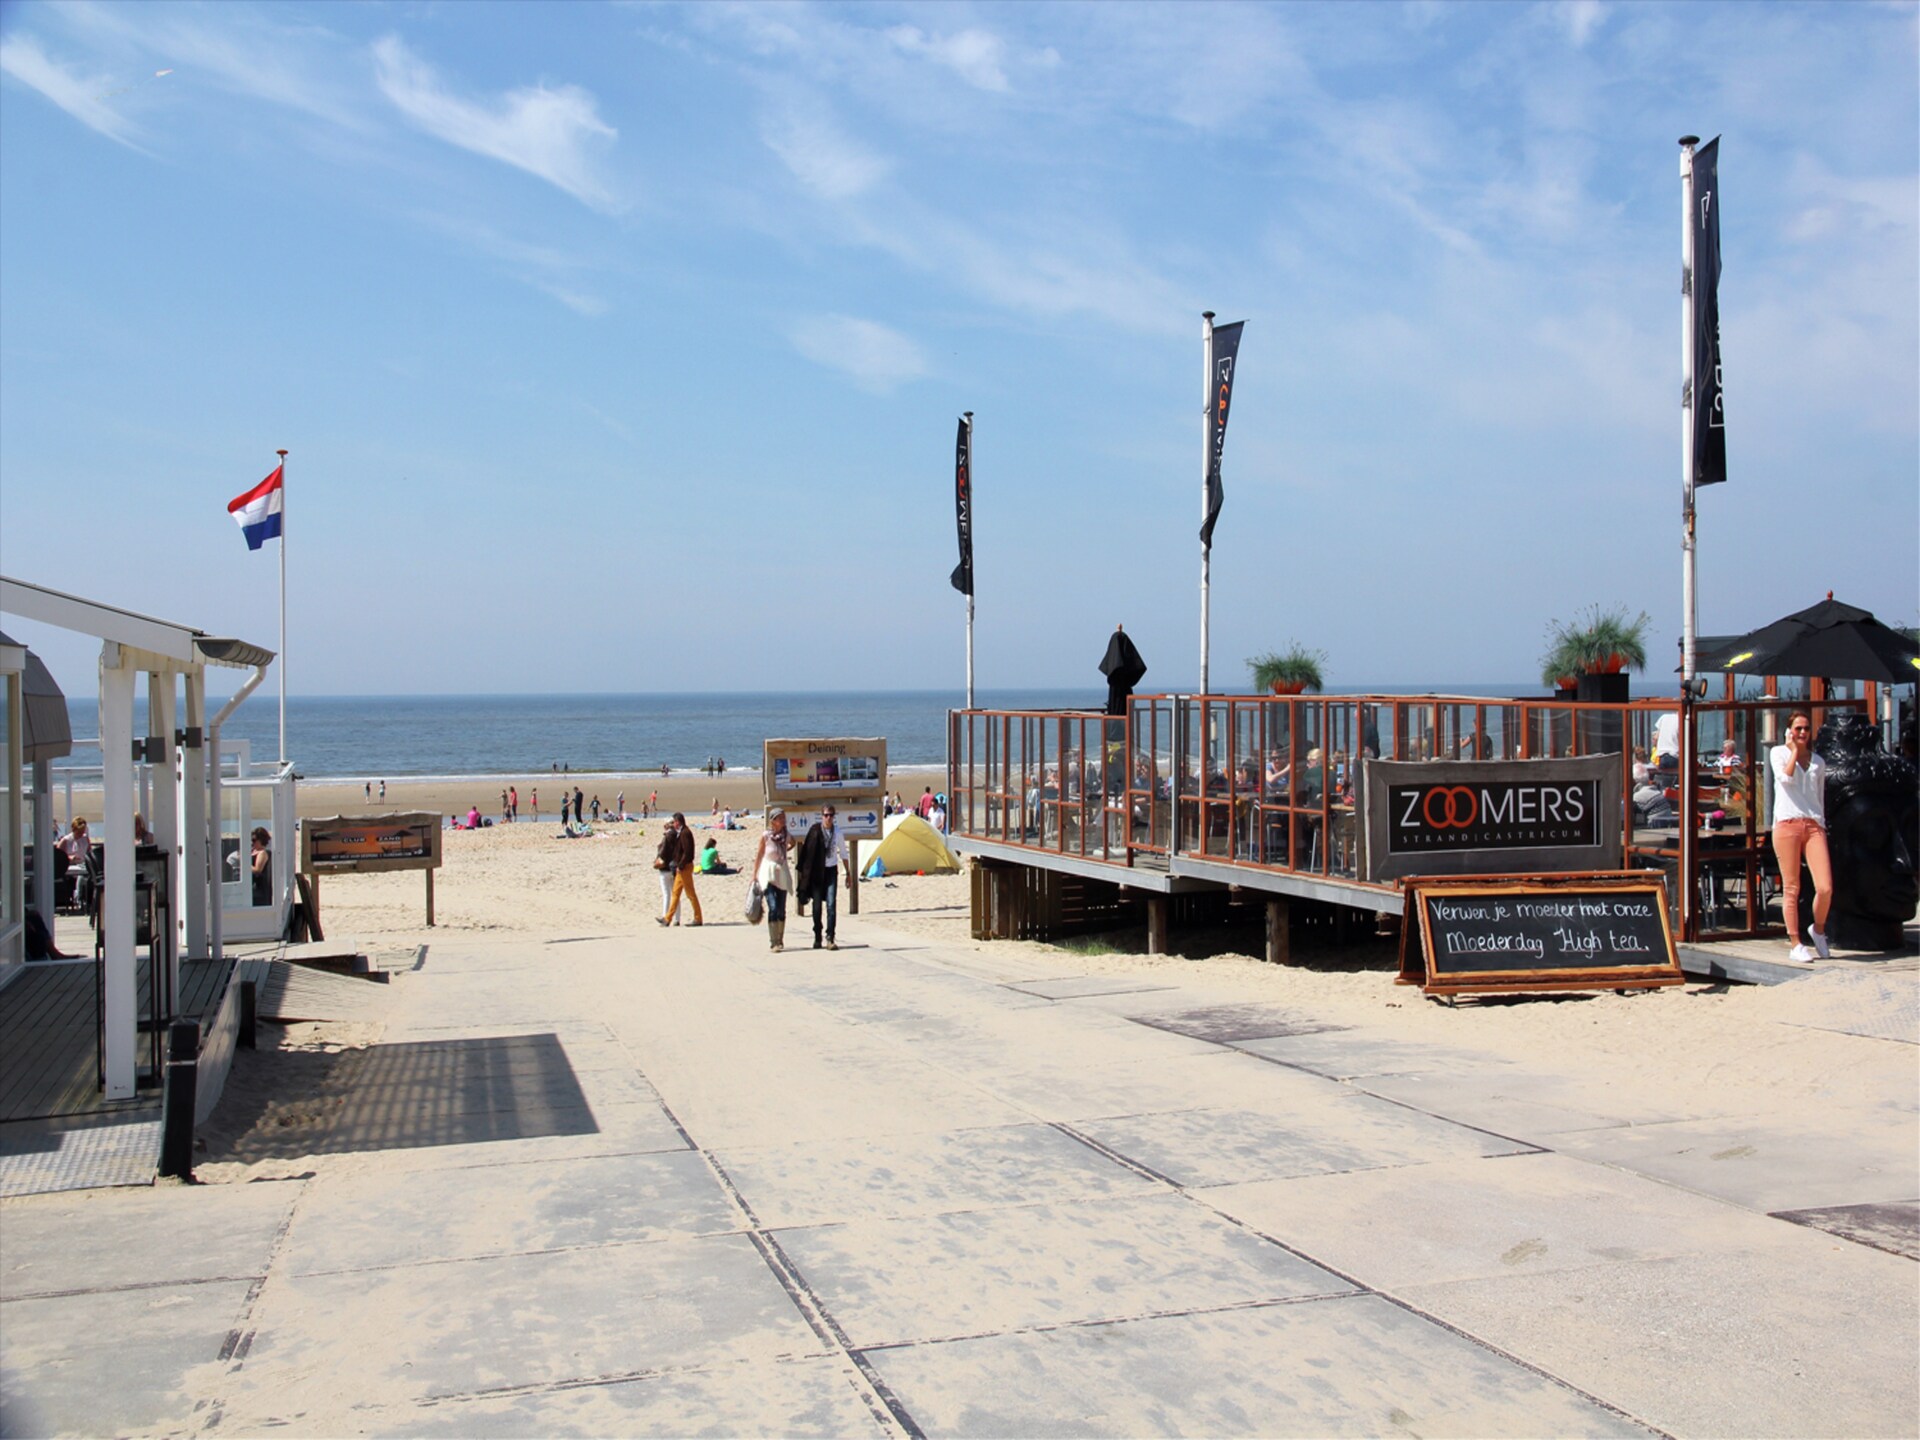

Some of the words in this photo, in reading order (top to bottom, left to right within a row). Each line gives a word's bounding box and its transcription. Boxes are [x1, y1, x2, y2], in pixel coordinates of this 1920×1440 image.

[808, 742, 846, 755] Deining
[1400, 785, 1584, 829] ZOOMERS
[1484, 830, 1581, 840] CASTRICUM
[1429, 898, 1491, 921] Verwen
[1492, 901, 1511, 922] je
[1516, 902, 1575, 918] moeder
[1579, 899, 1612, 917] met
[1553, 927, 1603, 959] High
